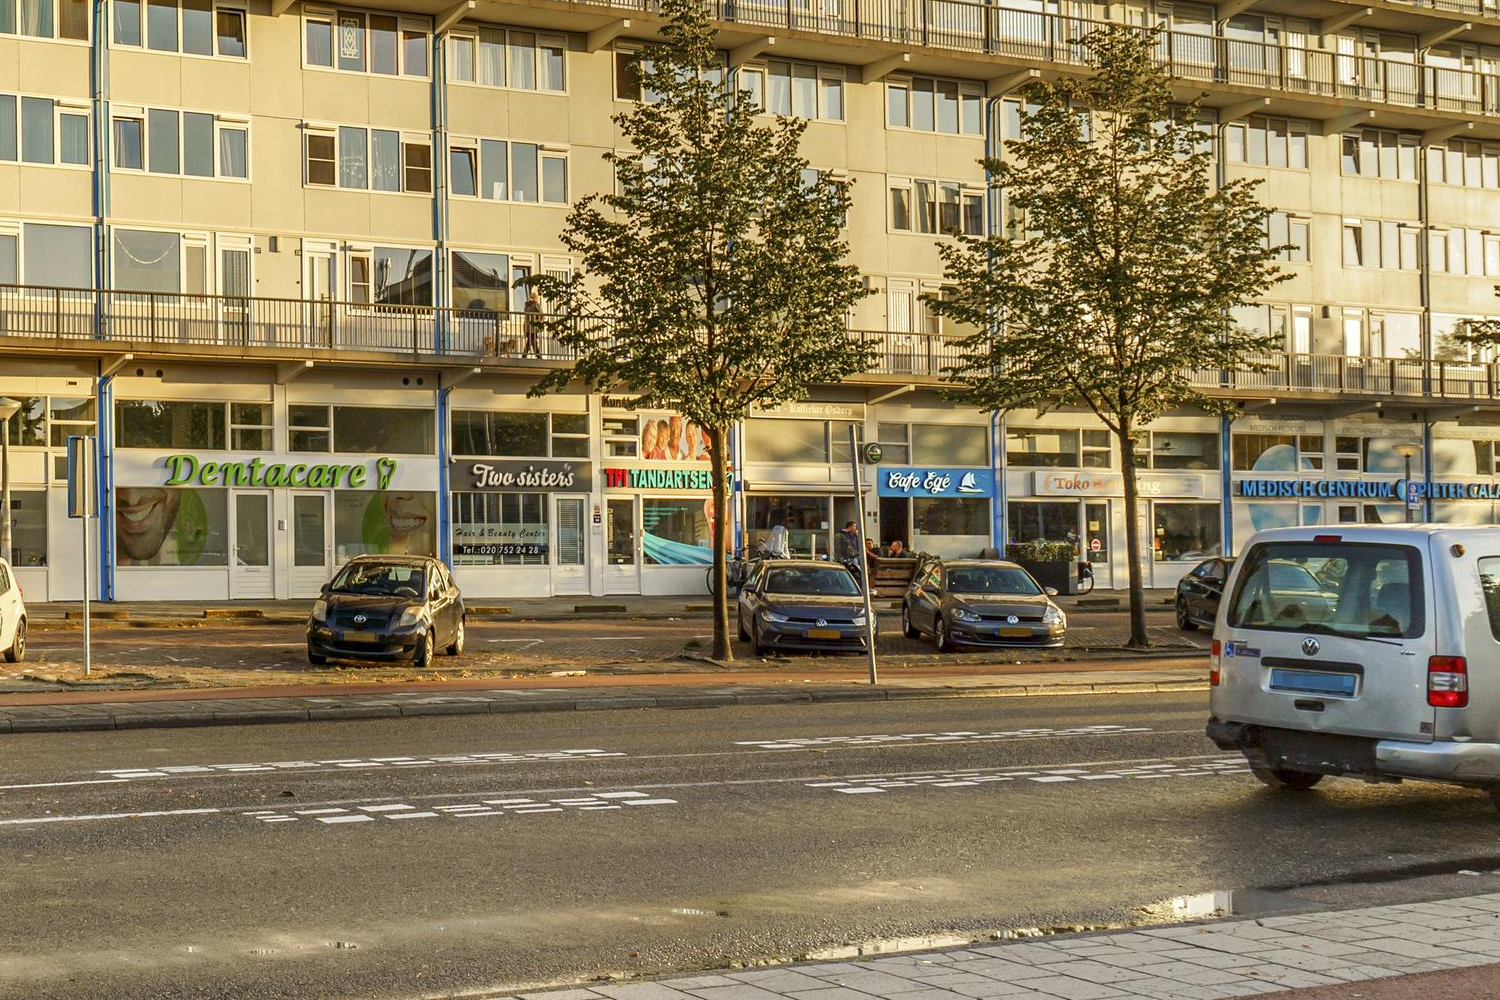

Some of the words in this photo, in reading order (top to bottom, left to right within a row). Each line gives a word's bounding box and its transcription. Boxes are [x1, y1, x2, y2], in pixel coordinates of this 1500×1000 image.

[825, 405, 853, 416] Osdorp
[164, 454, 367, 489] Dentacare
[472, 463, 515, 488] Two
[517, 465, 575, 488] sisters
[604, 468, 628, 488] TPI
[630, 469, 714, 489] TANDARTSEN
[888, 471, 921, 493] Cafe
[922, 471, 951, 494] Egé
[1053, 473, 1090, 491] Toko
[1241, 480, 1317, 498] MEDISCH
[1318, 481, 1393, 499] CENTRUM
[1417, 482, 1464, 498] PIETER
[454, 528, 476, 537] Hair
[479, 528, 485, 537] &
[487, 528, 516, 538] Beauty
[519, 527, 546, 538] Center
[499, 546, 514, 554] 752
[516, 546, 527, 554] 24
[528, 546, 539, 554] 28
